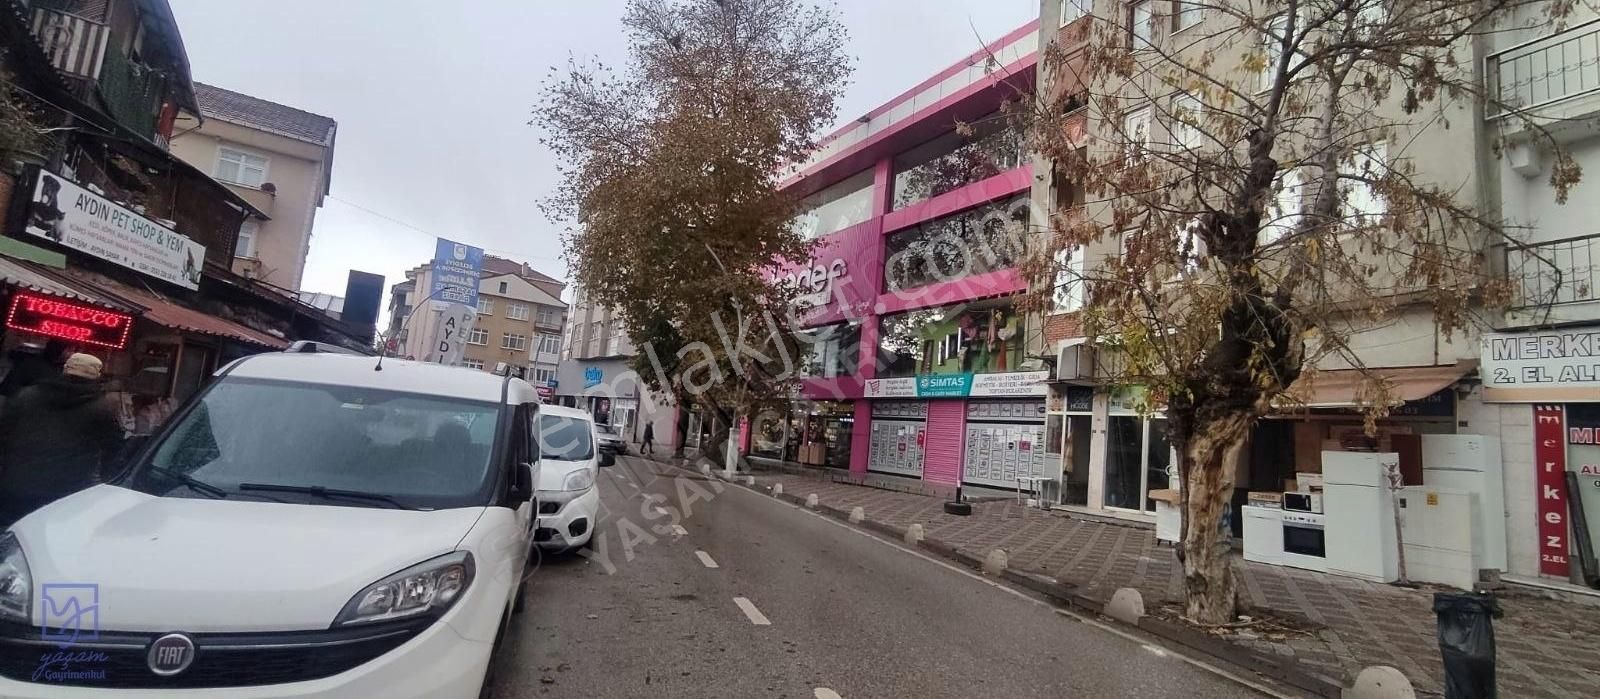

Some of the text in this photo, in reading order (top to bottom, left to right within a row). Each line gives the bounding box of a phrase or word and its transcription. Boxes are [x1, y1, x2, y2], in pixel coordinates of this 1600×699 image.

[75, 193, 110, 221] AYDIN
[111, 208, 130, 230] PET
[131, 218, 157, 240] SHOP
[157, 230, 165, 245] &
[167, 234, 184, 254] YEM
[26, 299, 120, 328] TOBACCO
[41, 320, 92, 340] SHOP
[1494, 367, 1516, 384] 2.
[1522, 366, 1554, 383] EL
[157, 646, 187, 665] FIAT
